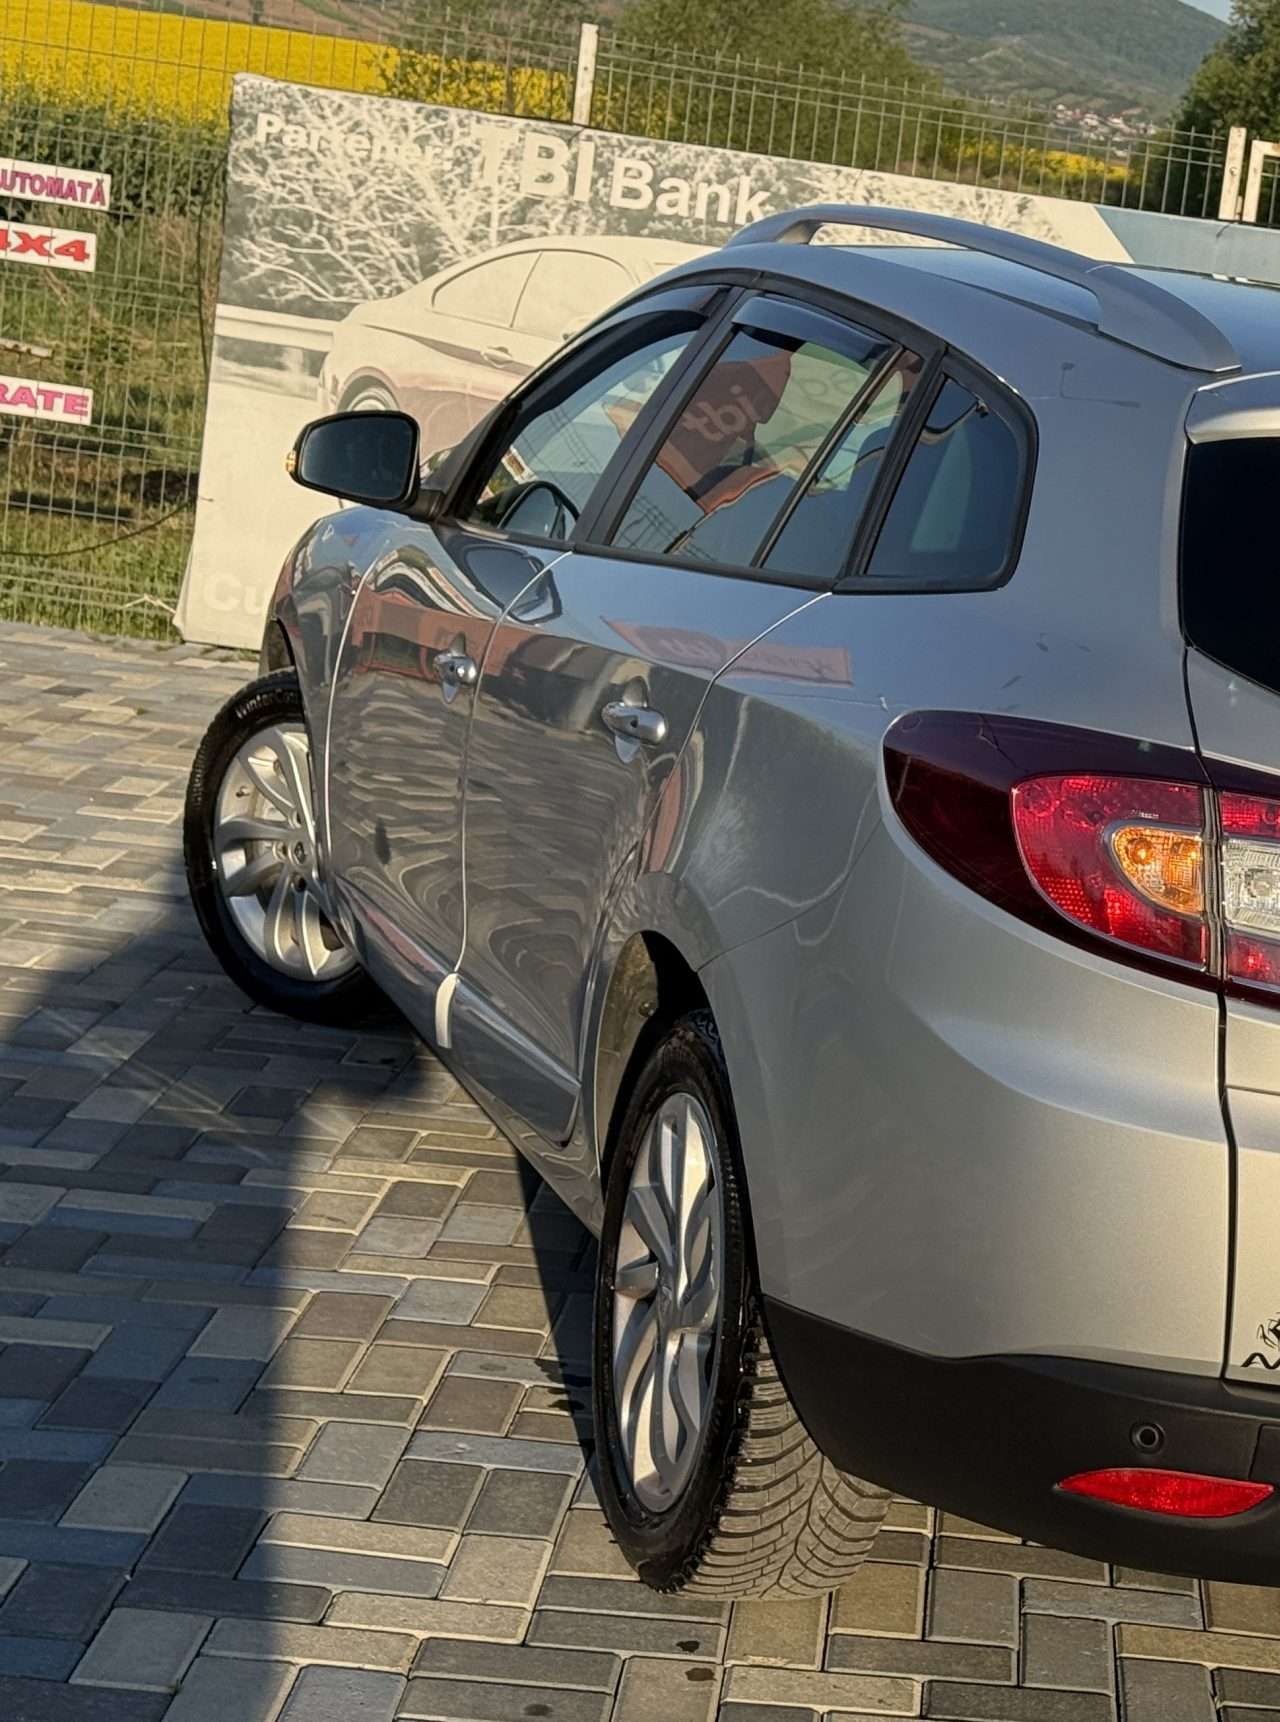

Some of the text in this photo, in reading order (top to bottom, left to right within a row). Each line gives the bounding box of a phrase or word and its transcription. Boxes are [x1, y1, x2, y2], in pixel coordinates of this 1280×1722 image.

[0, 168, 107, 207] UTOMATĂ
[472, 124, 597, 202] TBI
[608, 157, 772, 224] Bank
